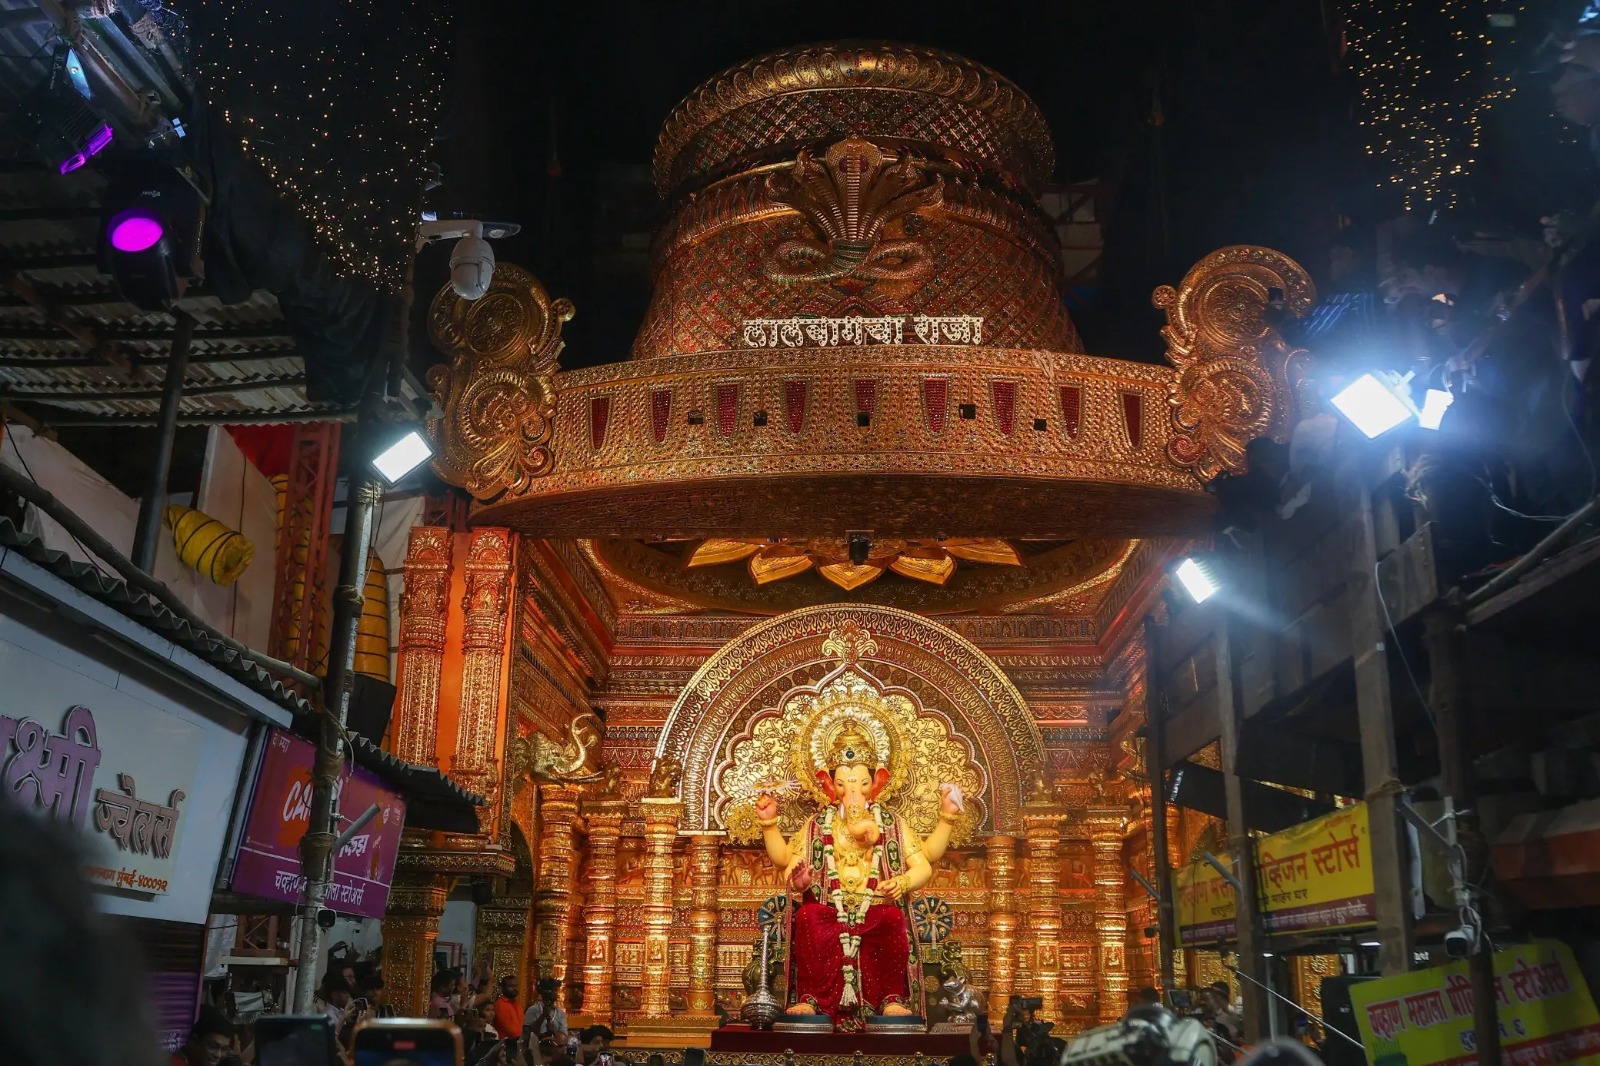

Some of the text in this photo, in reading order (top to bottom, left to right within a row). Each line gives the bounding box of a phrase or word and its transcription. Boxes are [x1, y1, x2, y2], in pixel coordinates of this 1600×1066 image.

[743, 314, 984, 347] लालबागचा राजा
[0, 704, 102, 832] क्ष्मी
[1257, 850, 1309, 889] व्हिजन
[1311, 825, 1361, 874] स्टोर्स
